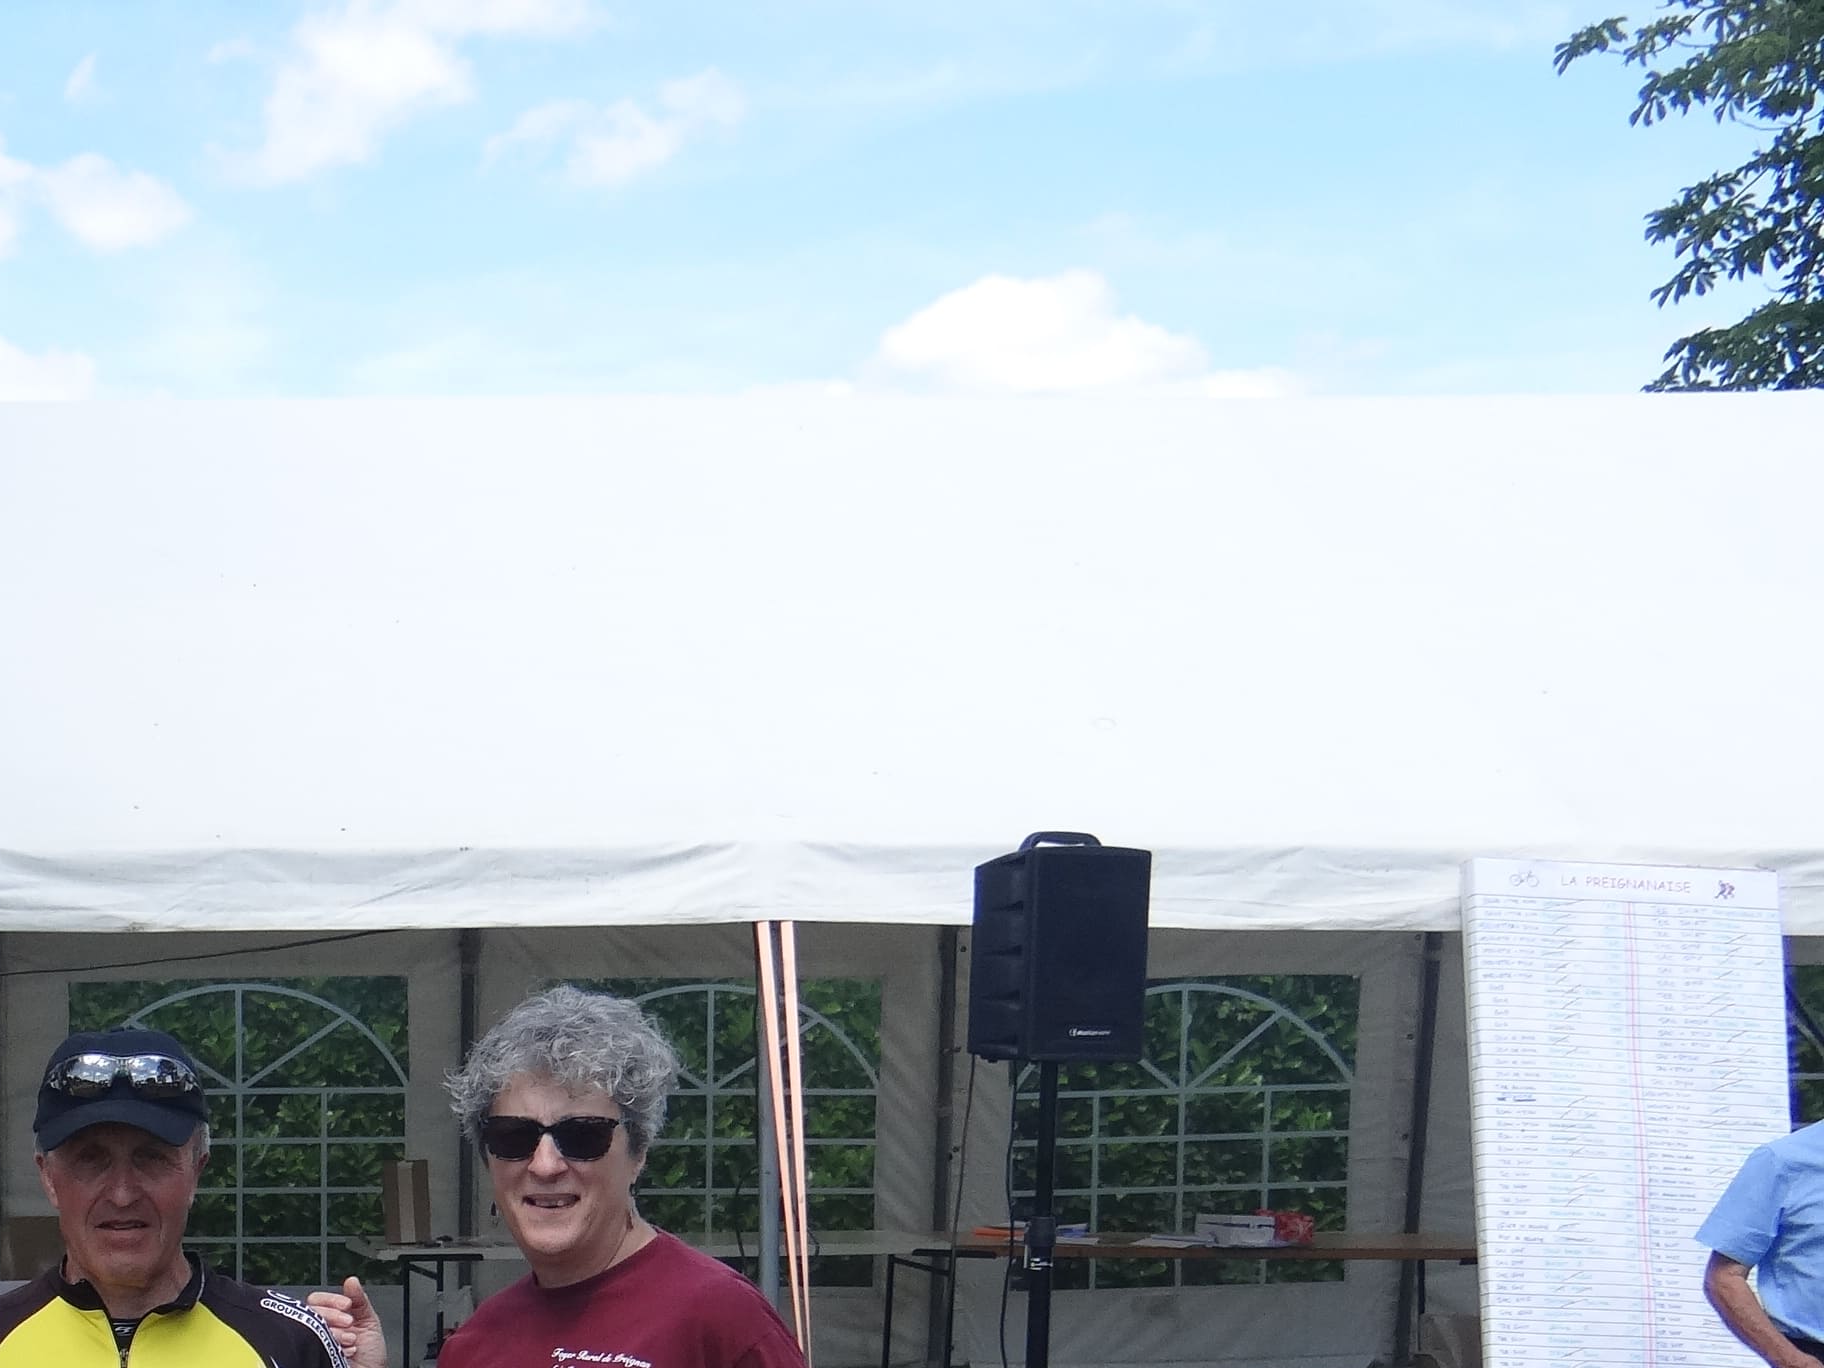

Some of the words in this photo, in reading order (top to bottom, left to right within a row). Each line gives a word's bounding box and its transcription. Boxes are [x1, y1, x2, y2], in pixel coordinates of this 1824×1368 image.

[1560, 875, 1577, 887] LA
[1585, 876, 1692, 894] PREIGNANAISE
[262, 1299, 304, 1320] GROUPE
